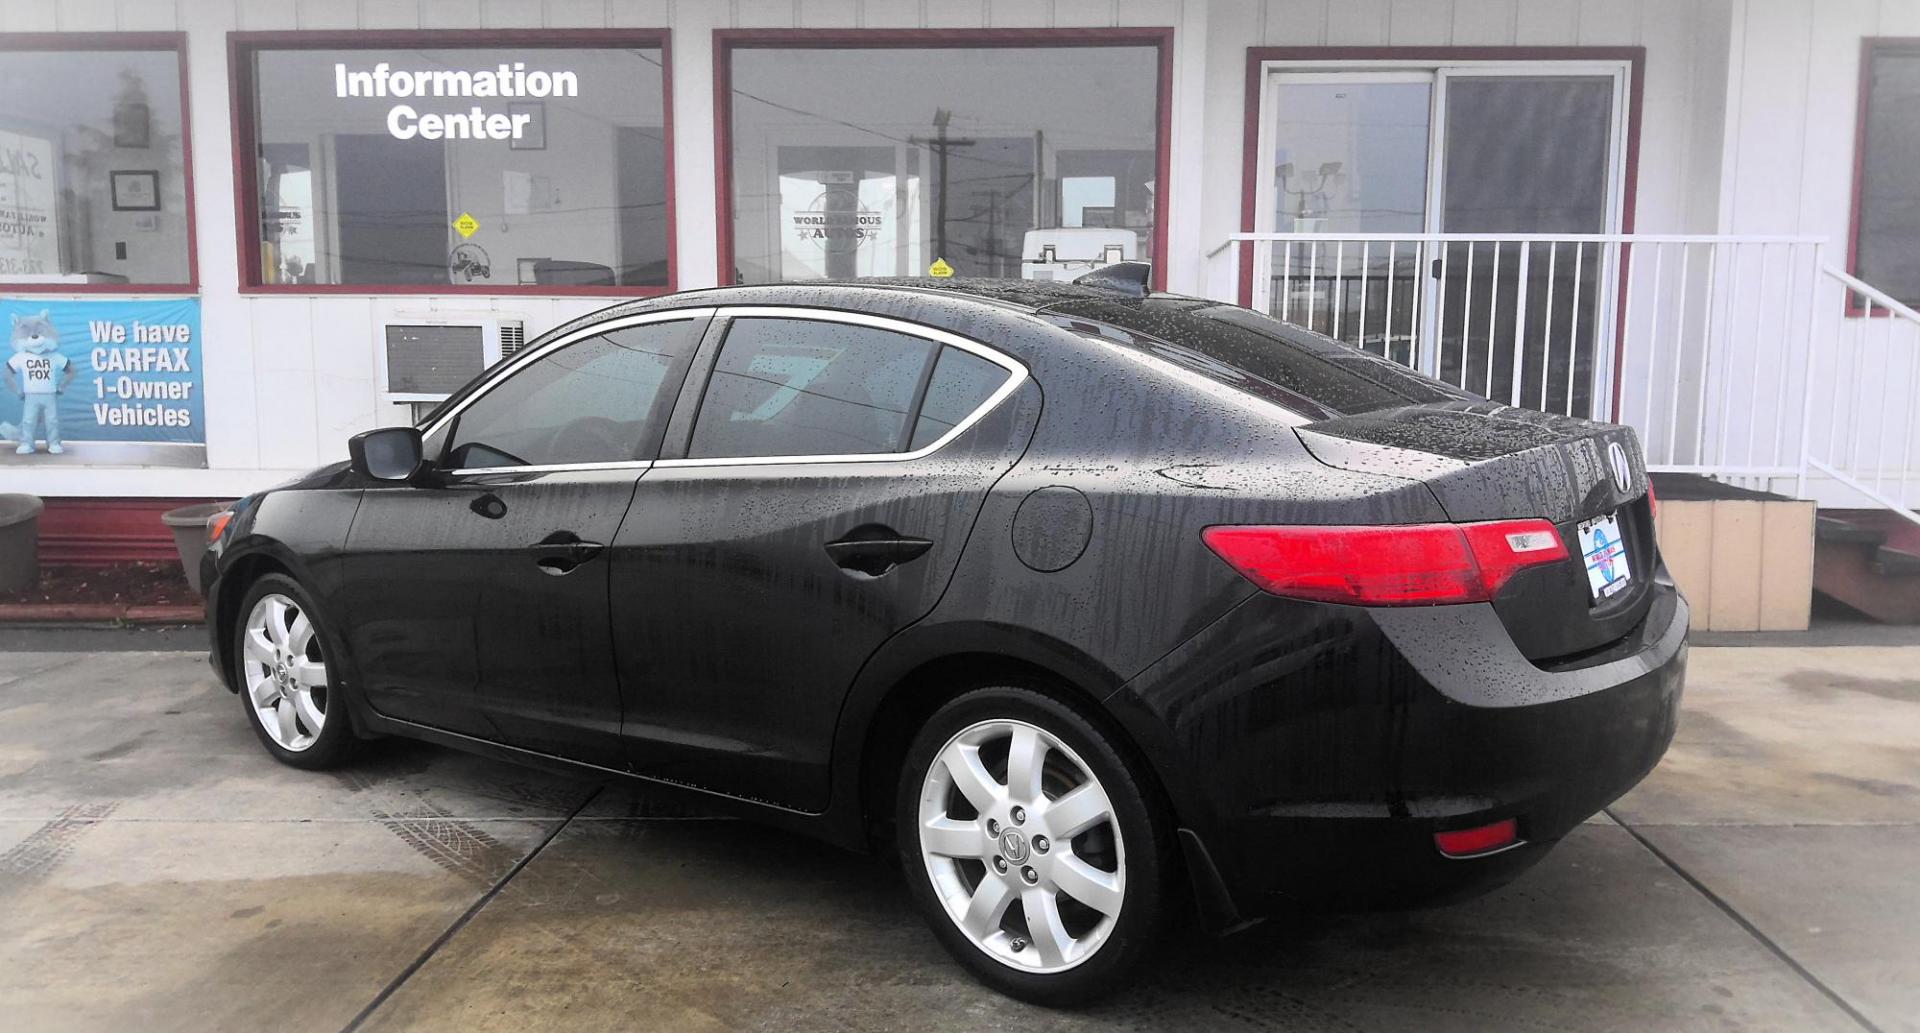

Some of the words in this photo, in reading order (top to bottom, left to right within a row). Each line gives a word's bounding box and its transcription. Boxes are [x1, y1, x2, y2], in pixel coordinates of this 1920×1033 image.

[335, 62, 578, 97] Information
[387, 104, 530, 140] Center
[813, 228, 865, 239] AUS
[89, 320, 126, 344] We
[133, 320, 191, 344] have
[26, 359, 50, 369] CAR
[91, 347, 191, 373] CARFAX
[28, 370, 50, 381] FOX
[93, 376, 192, 400] 1-Owner
[93, 403, 191, 427] Vehicles
